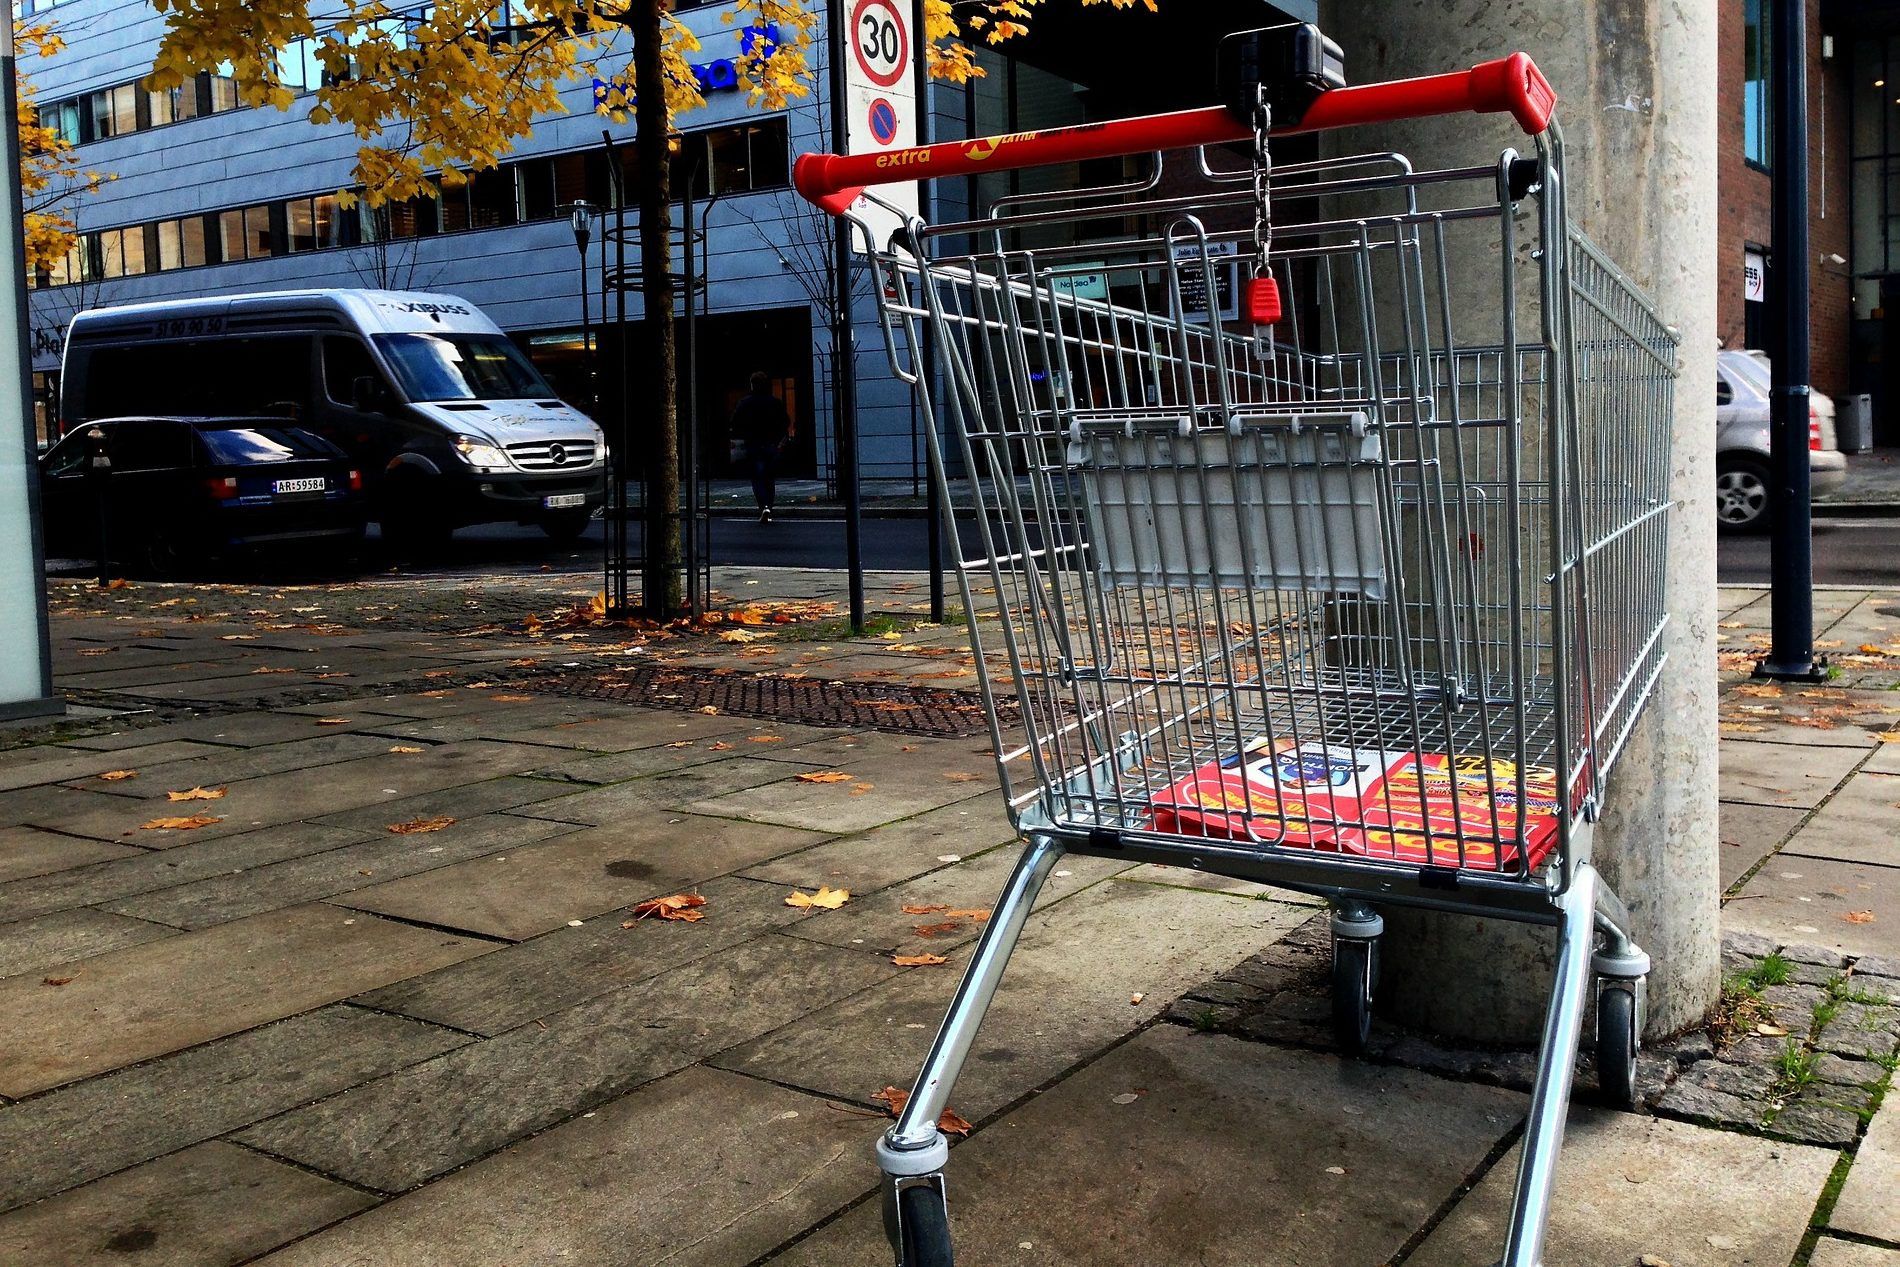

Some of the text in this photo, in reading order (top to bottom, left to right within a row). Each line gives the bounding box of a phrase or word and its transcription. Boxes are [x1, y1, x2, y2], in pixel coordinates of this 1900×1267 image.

[862, 14, 898, 64] 30
[876, 149, 931, 168] extra
[1060, 279, 1089, 289] Nodea
[170, 320, 186, 335] 90
